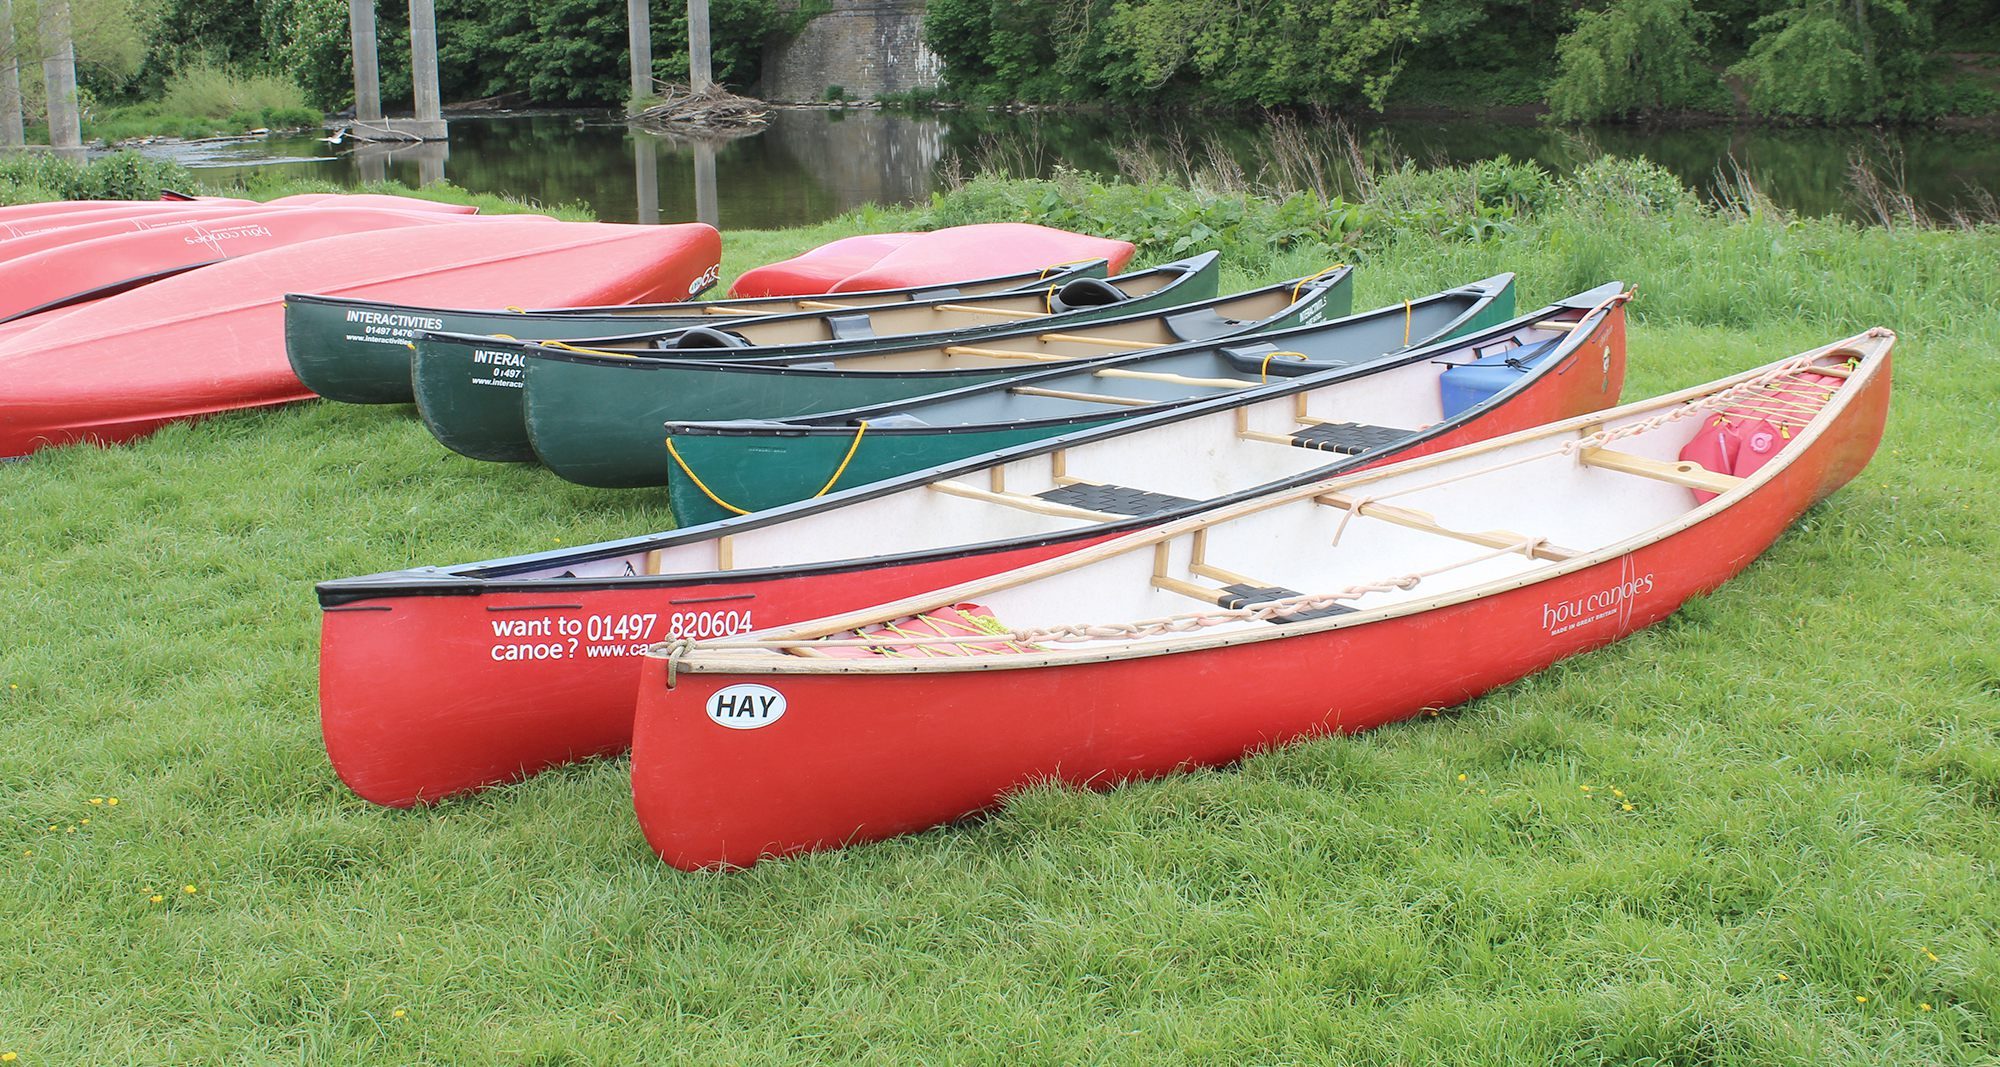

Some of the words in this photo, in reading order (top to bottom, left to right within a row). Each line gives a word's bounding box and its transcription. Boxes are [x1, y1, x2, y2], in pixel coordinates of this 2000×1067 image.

[346, 310, 443, 330] INTERACTIVITIES
[365, 325, 391, 335] 01497
[392, 327, 414, 338] 8476
[1586, 573, 1654, 613] canoes
[491, 617, 552, 637] want
[557, 616, 582, 636] to
[586, 614, 657, 642] 01497
[669, 610, 753, 639] 820604
[1576, 616, 1595, 627] GREAT
[586, 643, 651, 658] www.ca
[716, 695, 777, 718] HAY
